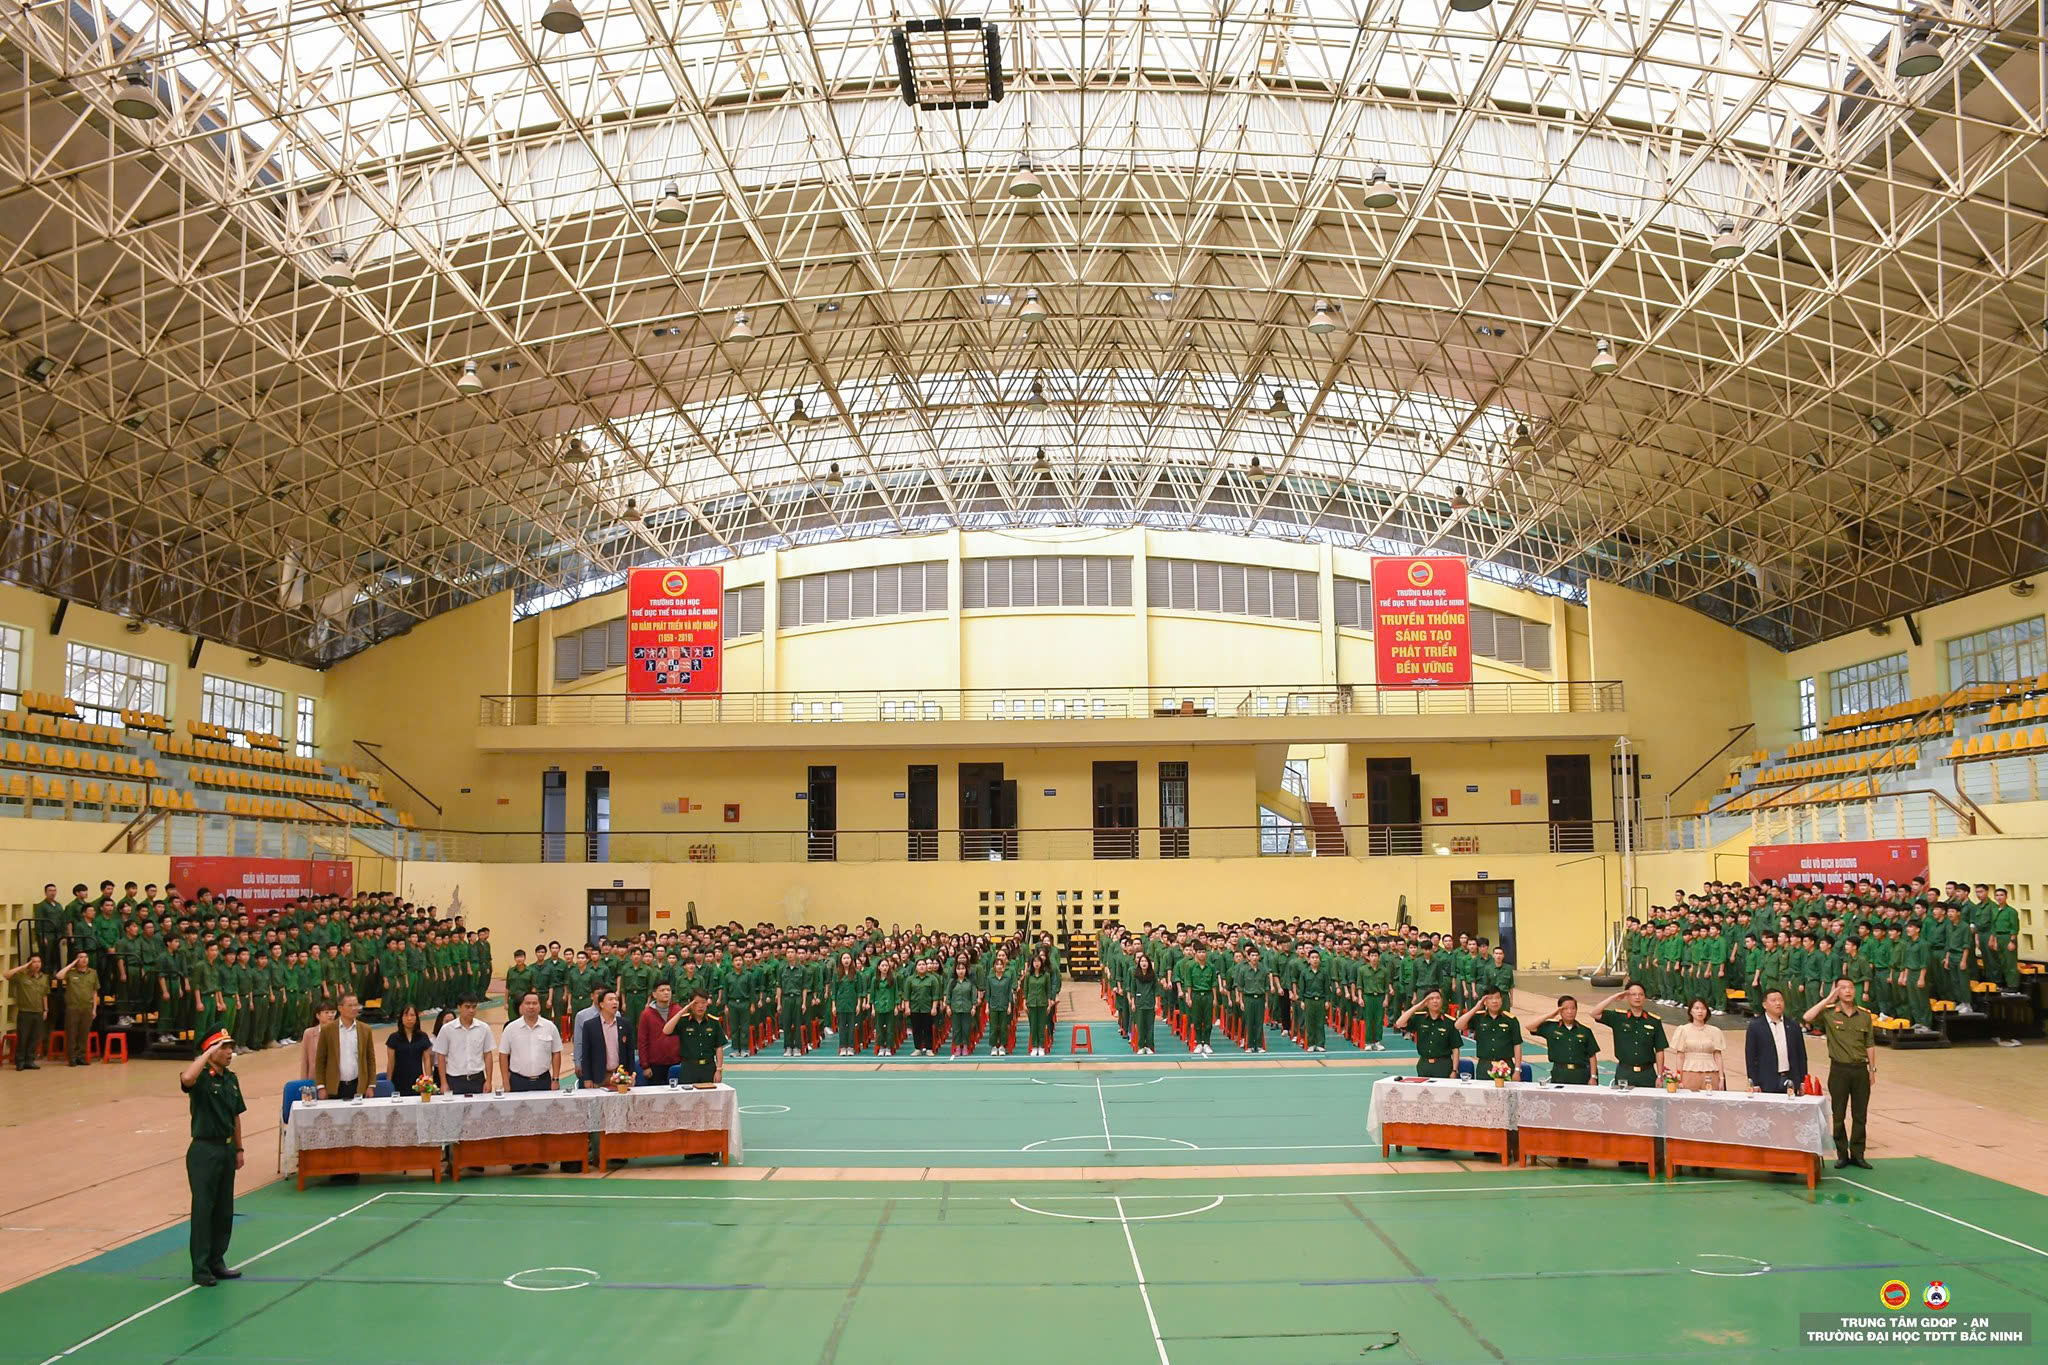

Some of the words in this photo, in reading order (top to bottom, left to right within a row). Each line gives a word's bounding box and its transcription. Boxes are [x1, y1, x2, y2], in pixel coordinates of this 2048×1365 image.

[1397, 588, 1420, 596] TRƯỜNG
[688, 607, 700, 615] BẮC
[1427, 610, 1465, 624] THỐNG
[1395, 628, 1427, 641] SÁNG
[1430, 630, 1452, 643] TẠO
[1391, 644, 1421, 657] PHÁT
[1424, 642, 1457, 657] TRIỂN
[1423, 660, 1453, 673] VỮNG
